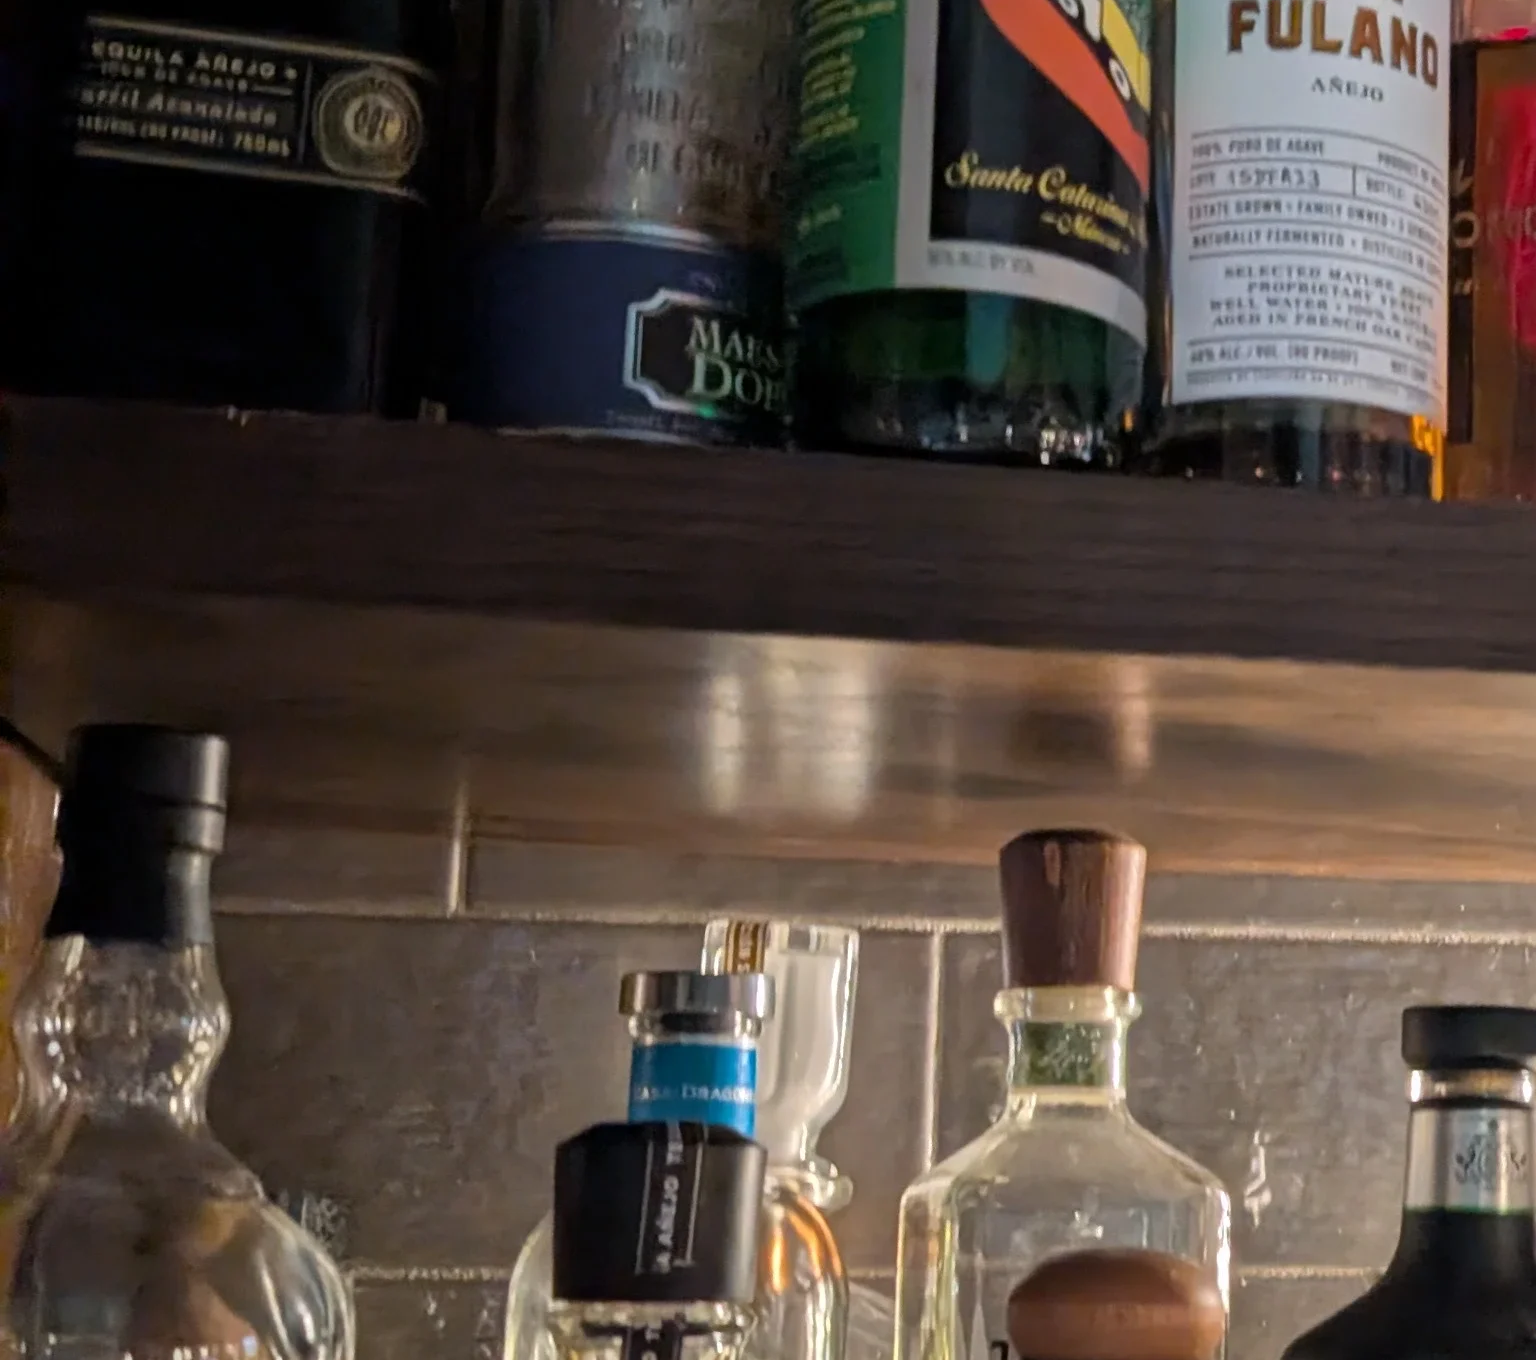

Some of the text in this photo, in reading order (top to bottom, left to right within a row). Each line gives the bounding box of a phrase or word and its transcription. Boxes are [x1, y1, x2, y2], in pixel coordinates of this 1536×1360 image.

[1310, 75, 1385, 104] AÑEJO
[945, 150, 1034, 194] Santa
[1224, 264, 1321, 280] SELECTED
[1265, 297, 1329, 312] WATER
